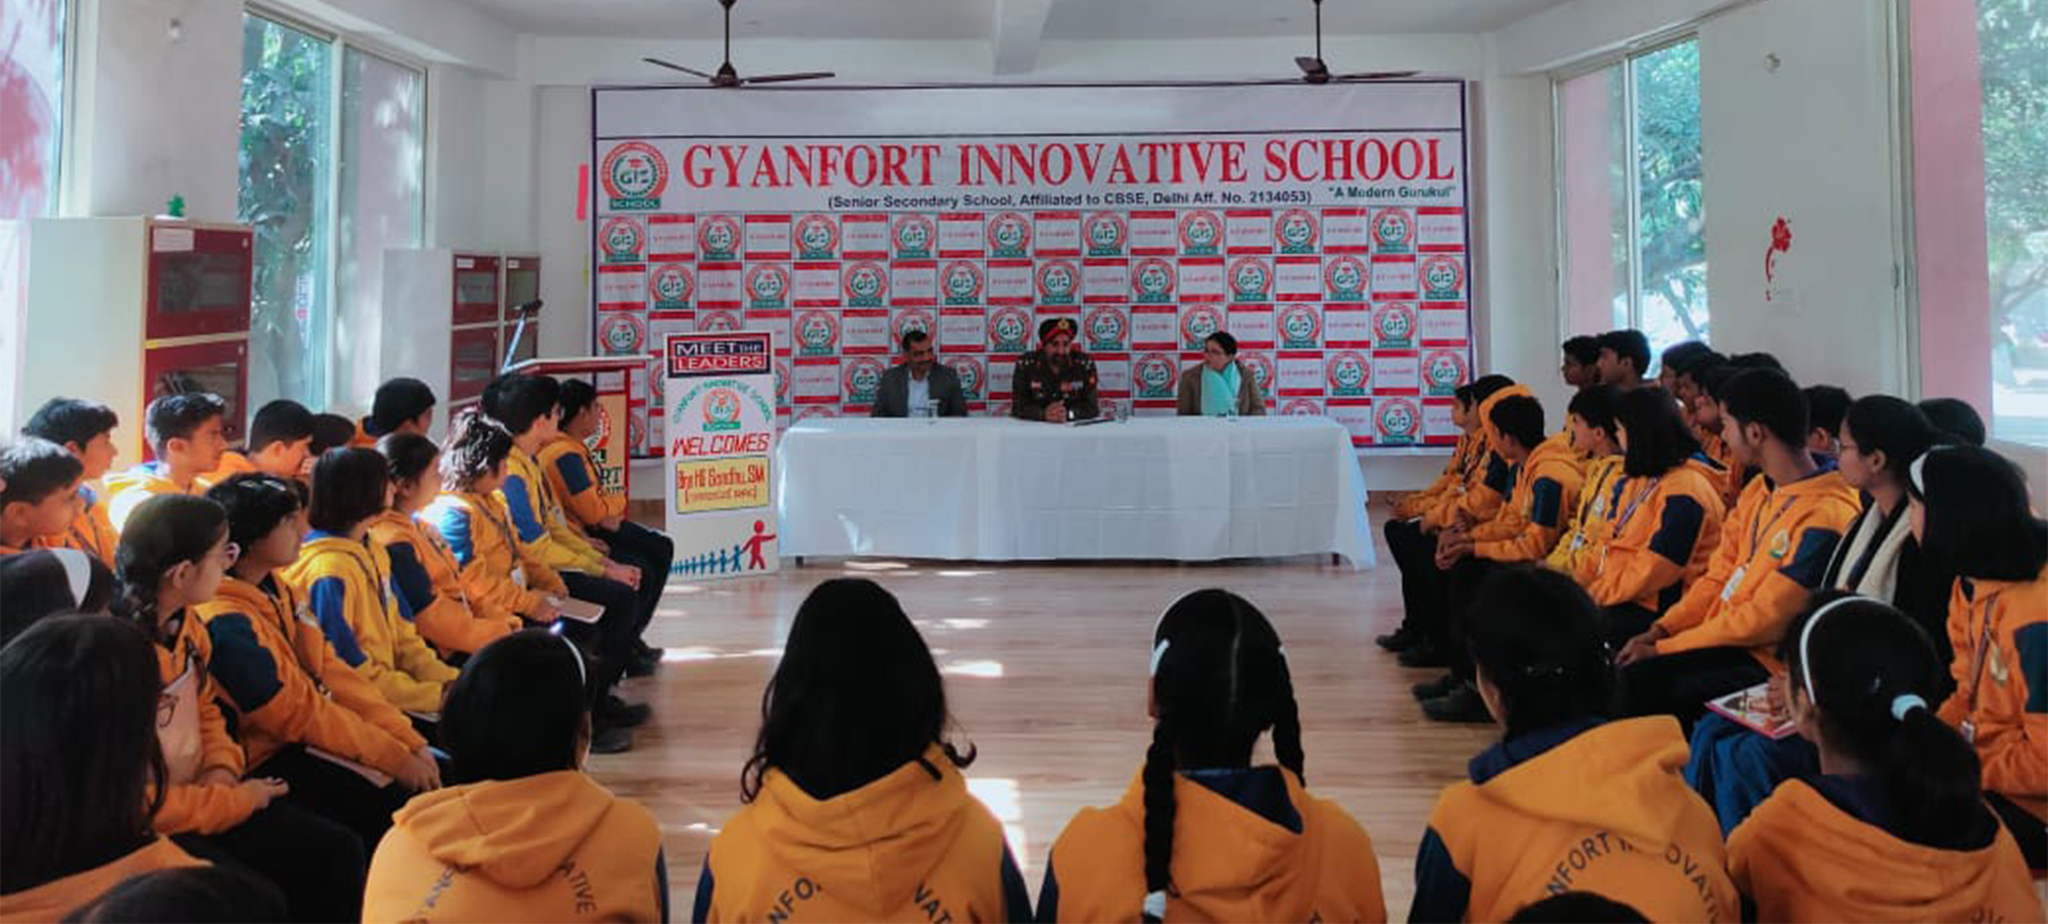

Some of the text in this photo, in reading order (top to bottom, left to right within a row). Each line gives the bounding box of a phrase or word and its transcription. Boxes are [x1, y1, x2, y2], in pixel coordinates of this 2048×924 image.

[683, 138, 1455, 189] GYANFORT INNOVATIVE SCHOOL
[828, 190, 1311, 210] (Senior Secondary School, Affiliated to CBSE, Delhi Aff. No. 2134053)
[1348, 186, 1395, 199] Modern
[677, 342, 762, 356] MEET THE
[678, 355, 763, 370] LEADERS
[672, 433, 771, 458] WELCOMES
[767, 876, 822, 924] NFO
